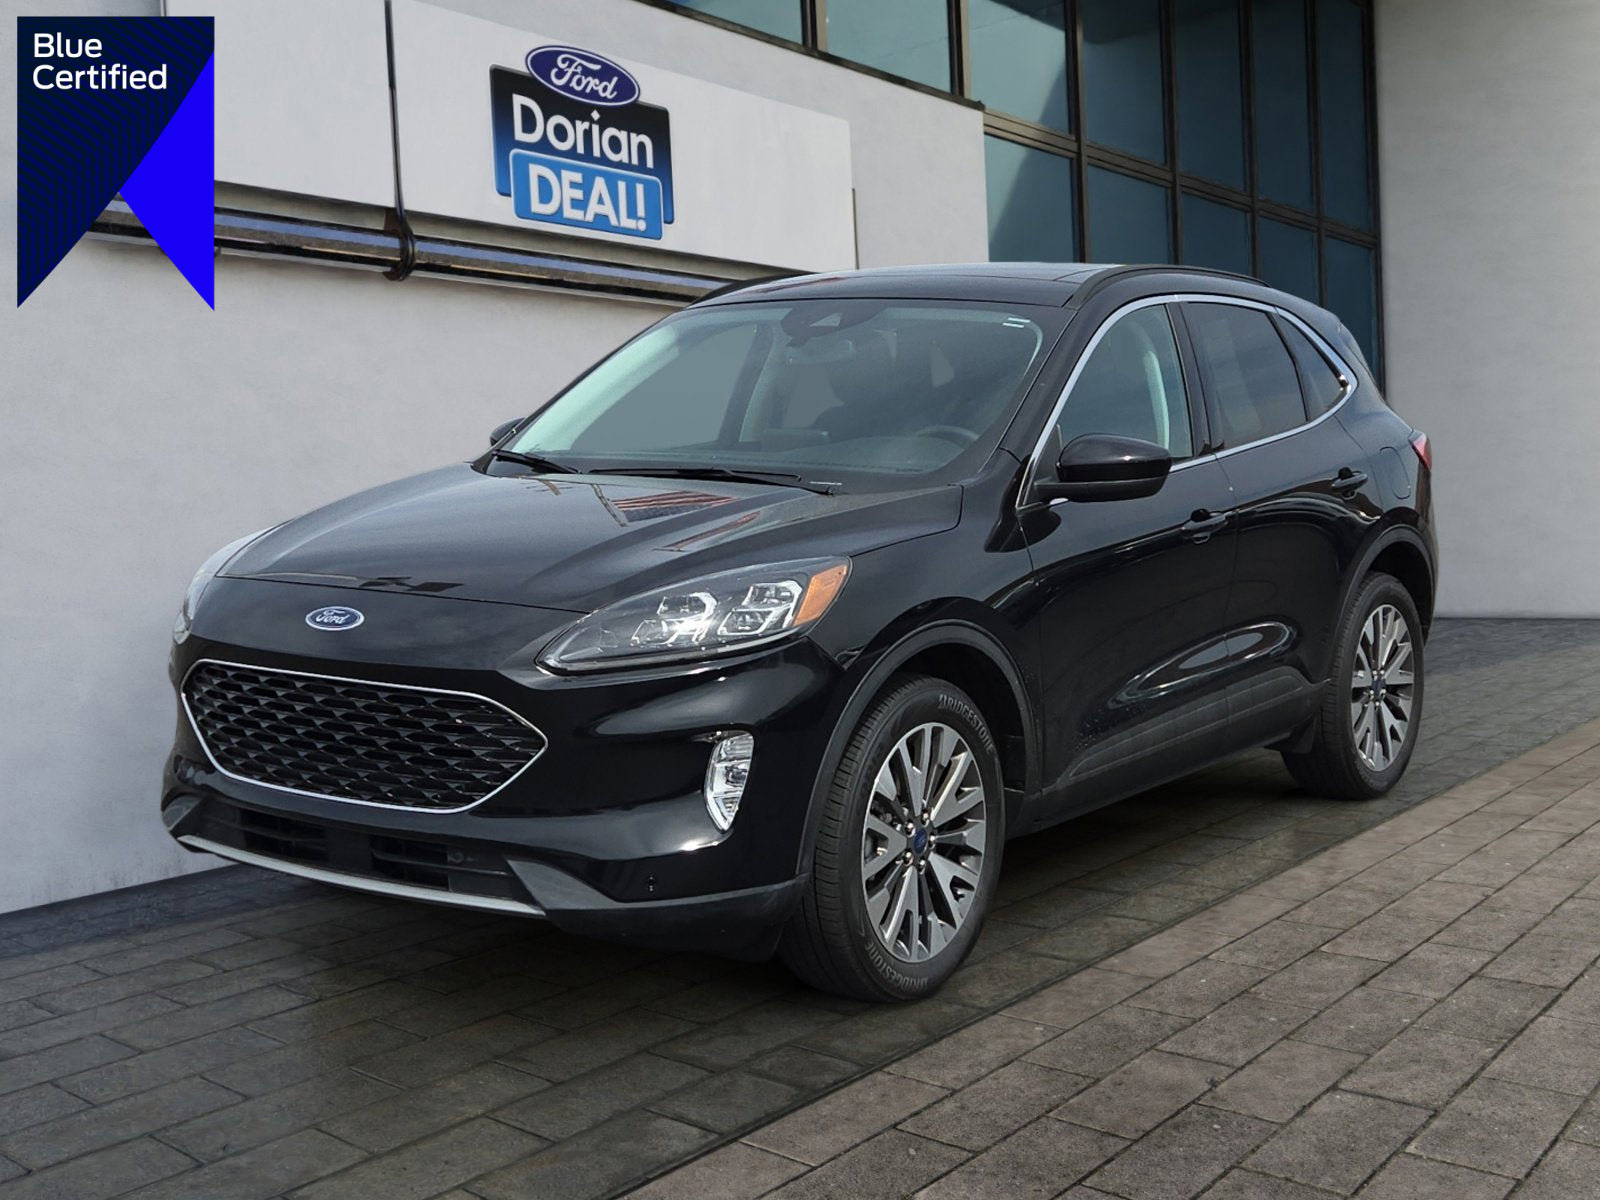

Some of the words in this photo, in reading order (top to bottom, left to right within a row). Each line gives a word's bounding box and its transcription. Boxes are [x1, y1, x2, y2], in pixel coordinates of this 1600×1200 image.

[550, 53, 618, 100] Ford
[512, 93, 654, 169] Dorian
[528, 163, 647, 232] DEAL!
[315, 609, 350, 625] Ford
[937, 693, 995, 756] BRIDGESTONE
